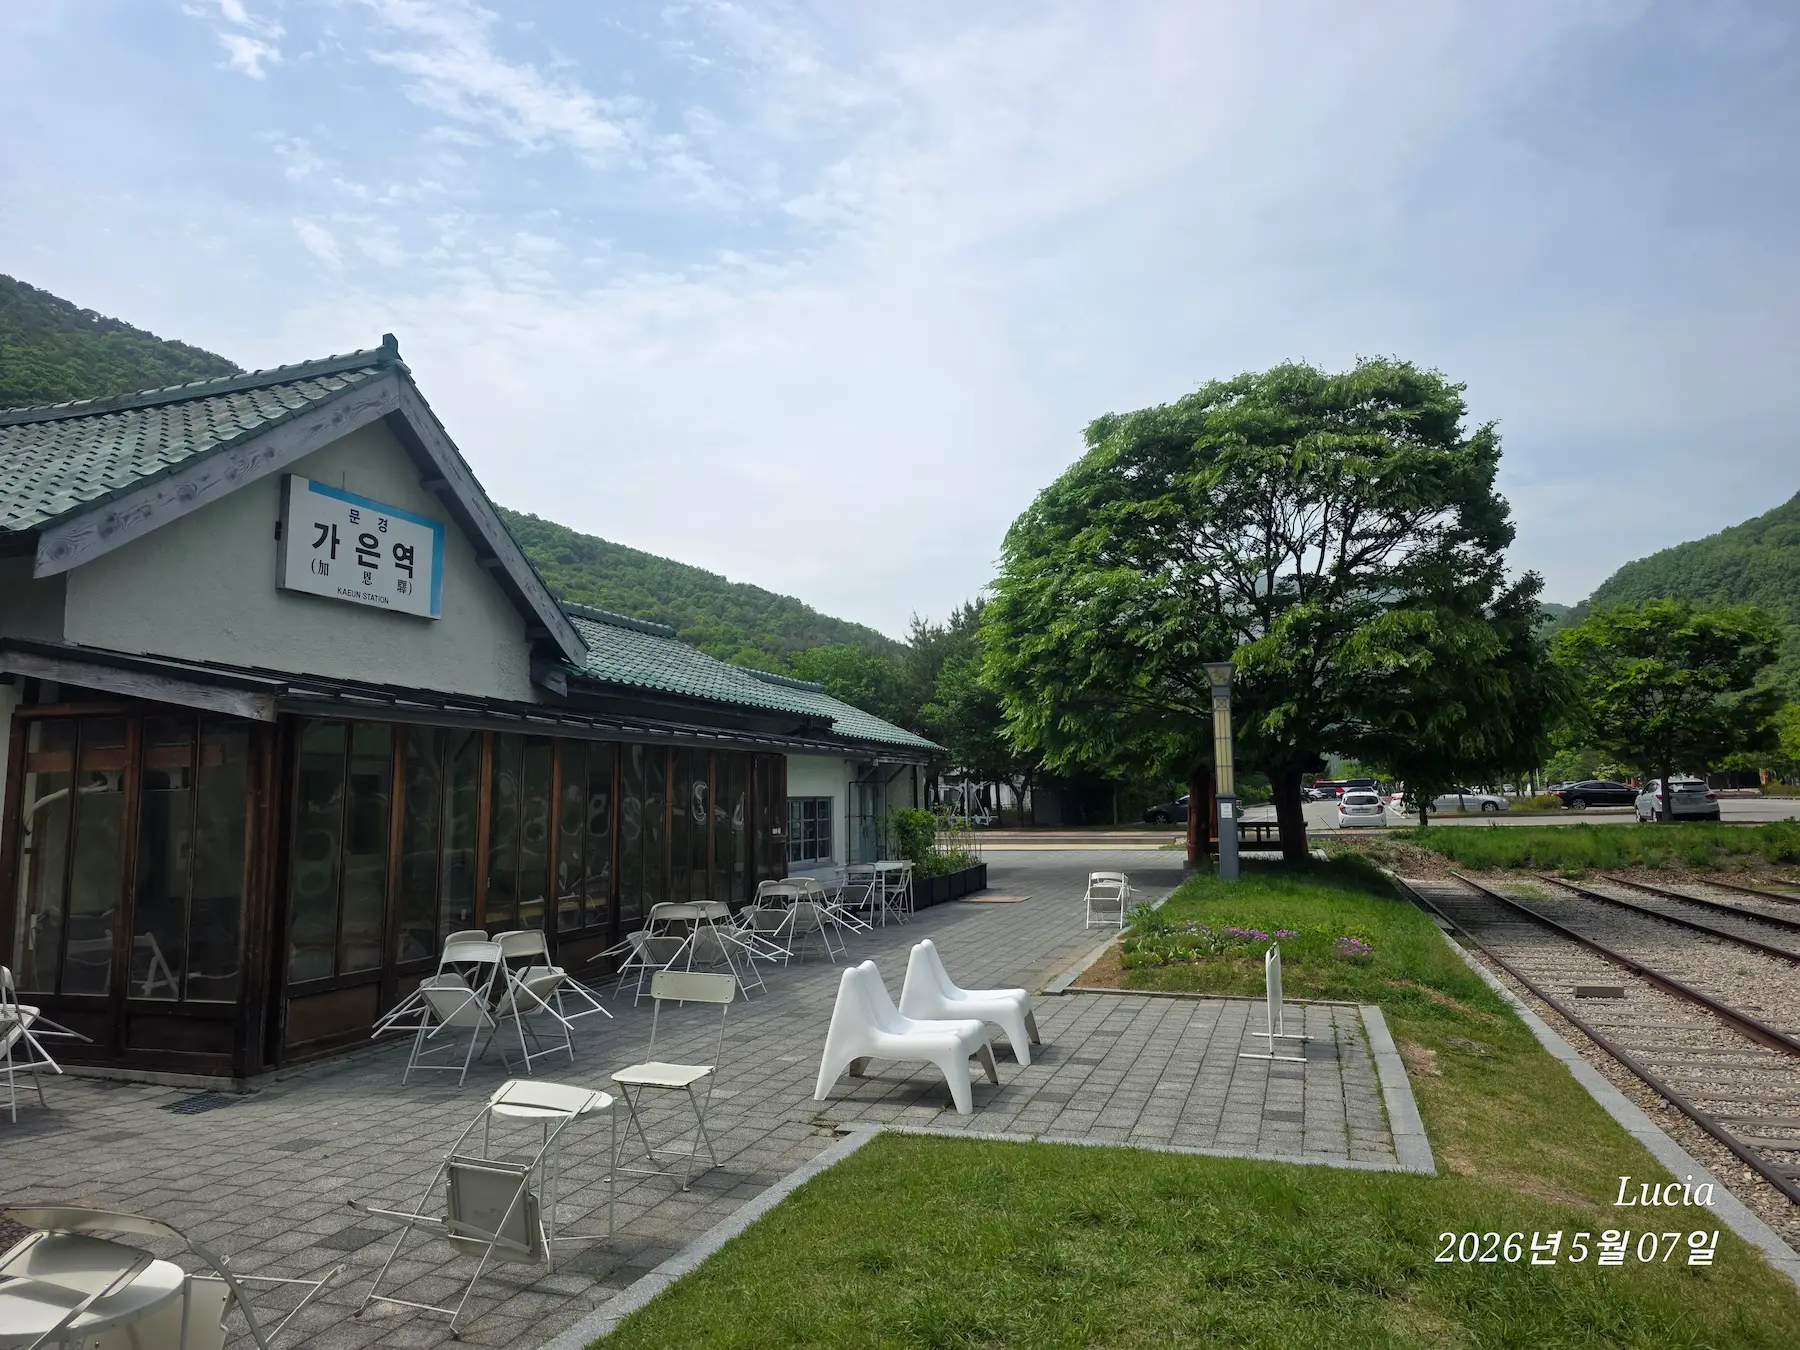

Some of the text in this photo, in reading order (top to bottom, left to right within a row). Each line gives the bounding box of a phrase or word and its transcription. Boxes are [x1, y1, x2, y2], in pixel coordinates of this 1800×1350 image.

[349, 508, 388, 533] 문경
[312, 522, 415, 579] 가은역
[337, 586, 390, 605] KAEUN STATION
